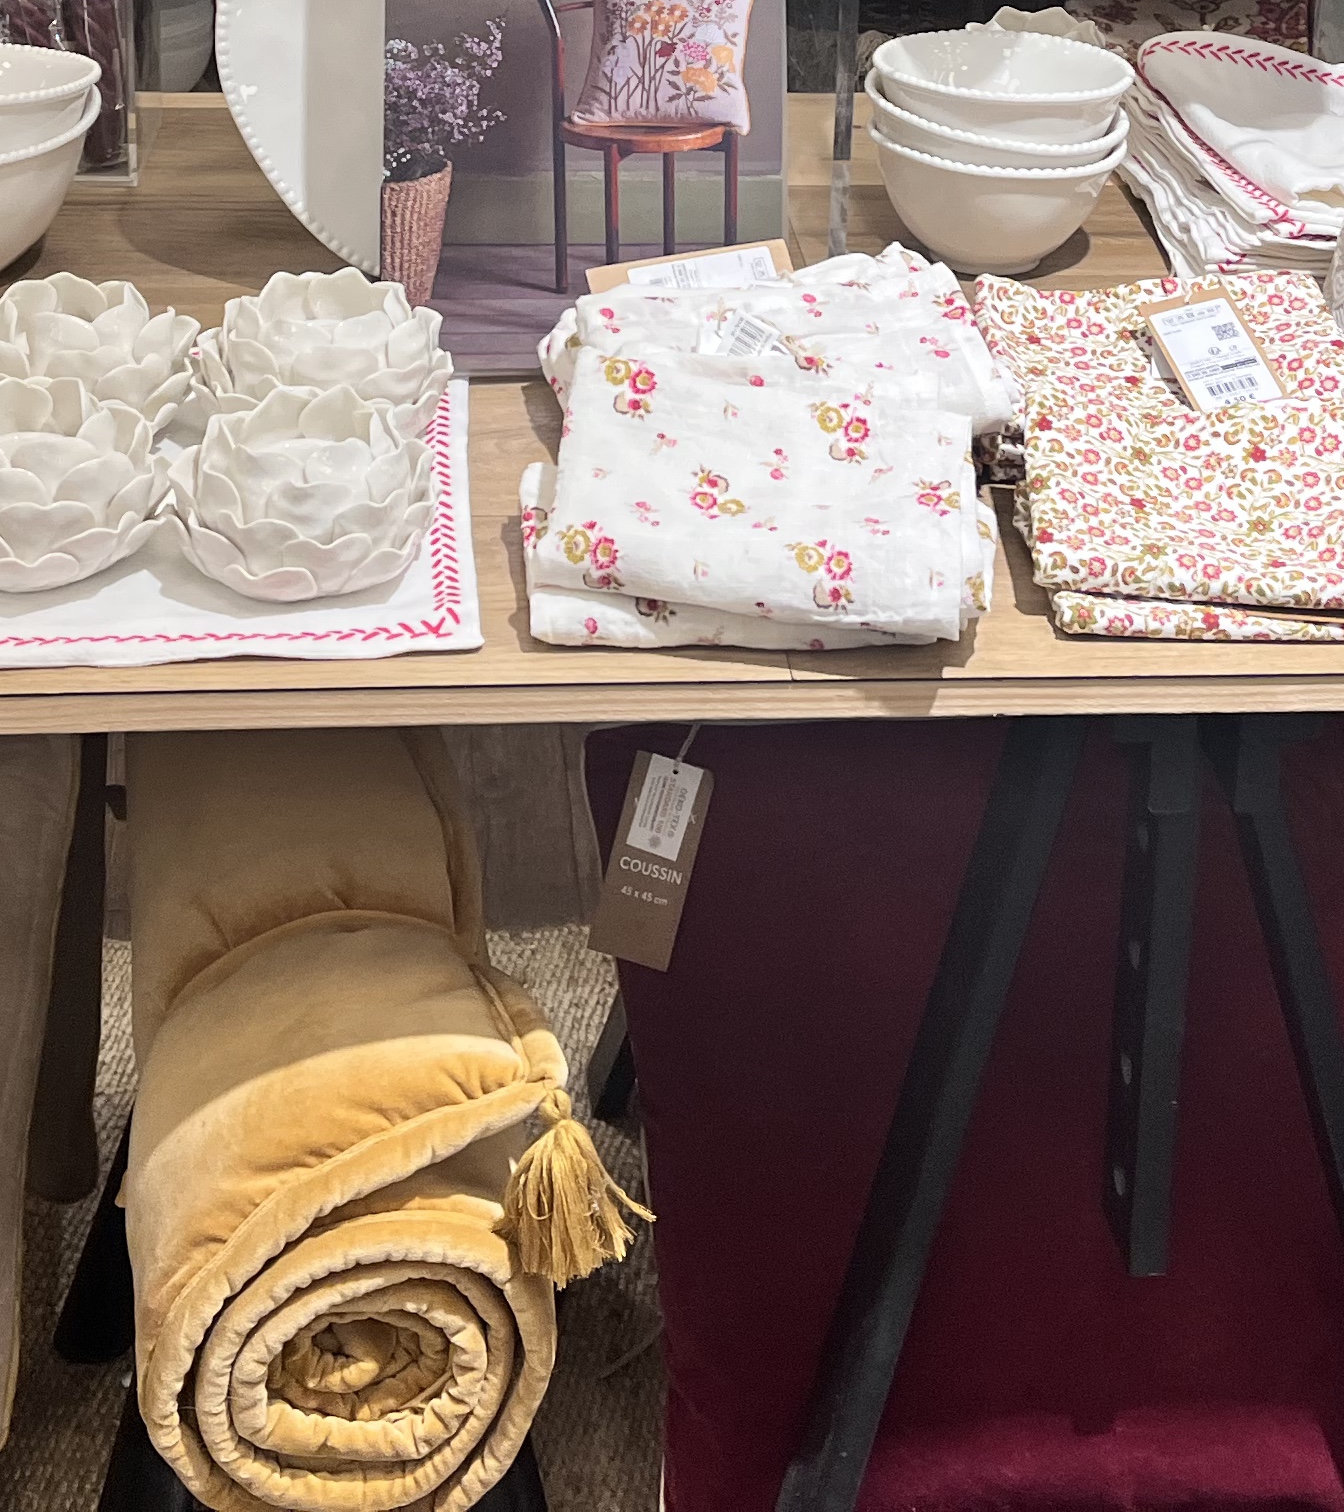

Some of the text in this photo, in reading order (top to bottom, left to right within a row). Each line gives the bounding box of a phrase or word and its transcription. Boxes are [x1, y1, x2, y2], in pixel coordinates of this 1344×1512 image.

[619, 855, 684, 885] COUSSIN
[620, 885, 632, 897] 45
[641, 890, 653, 902] 45
[653, 896, 668, 906] cm
